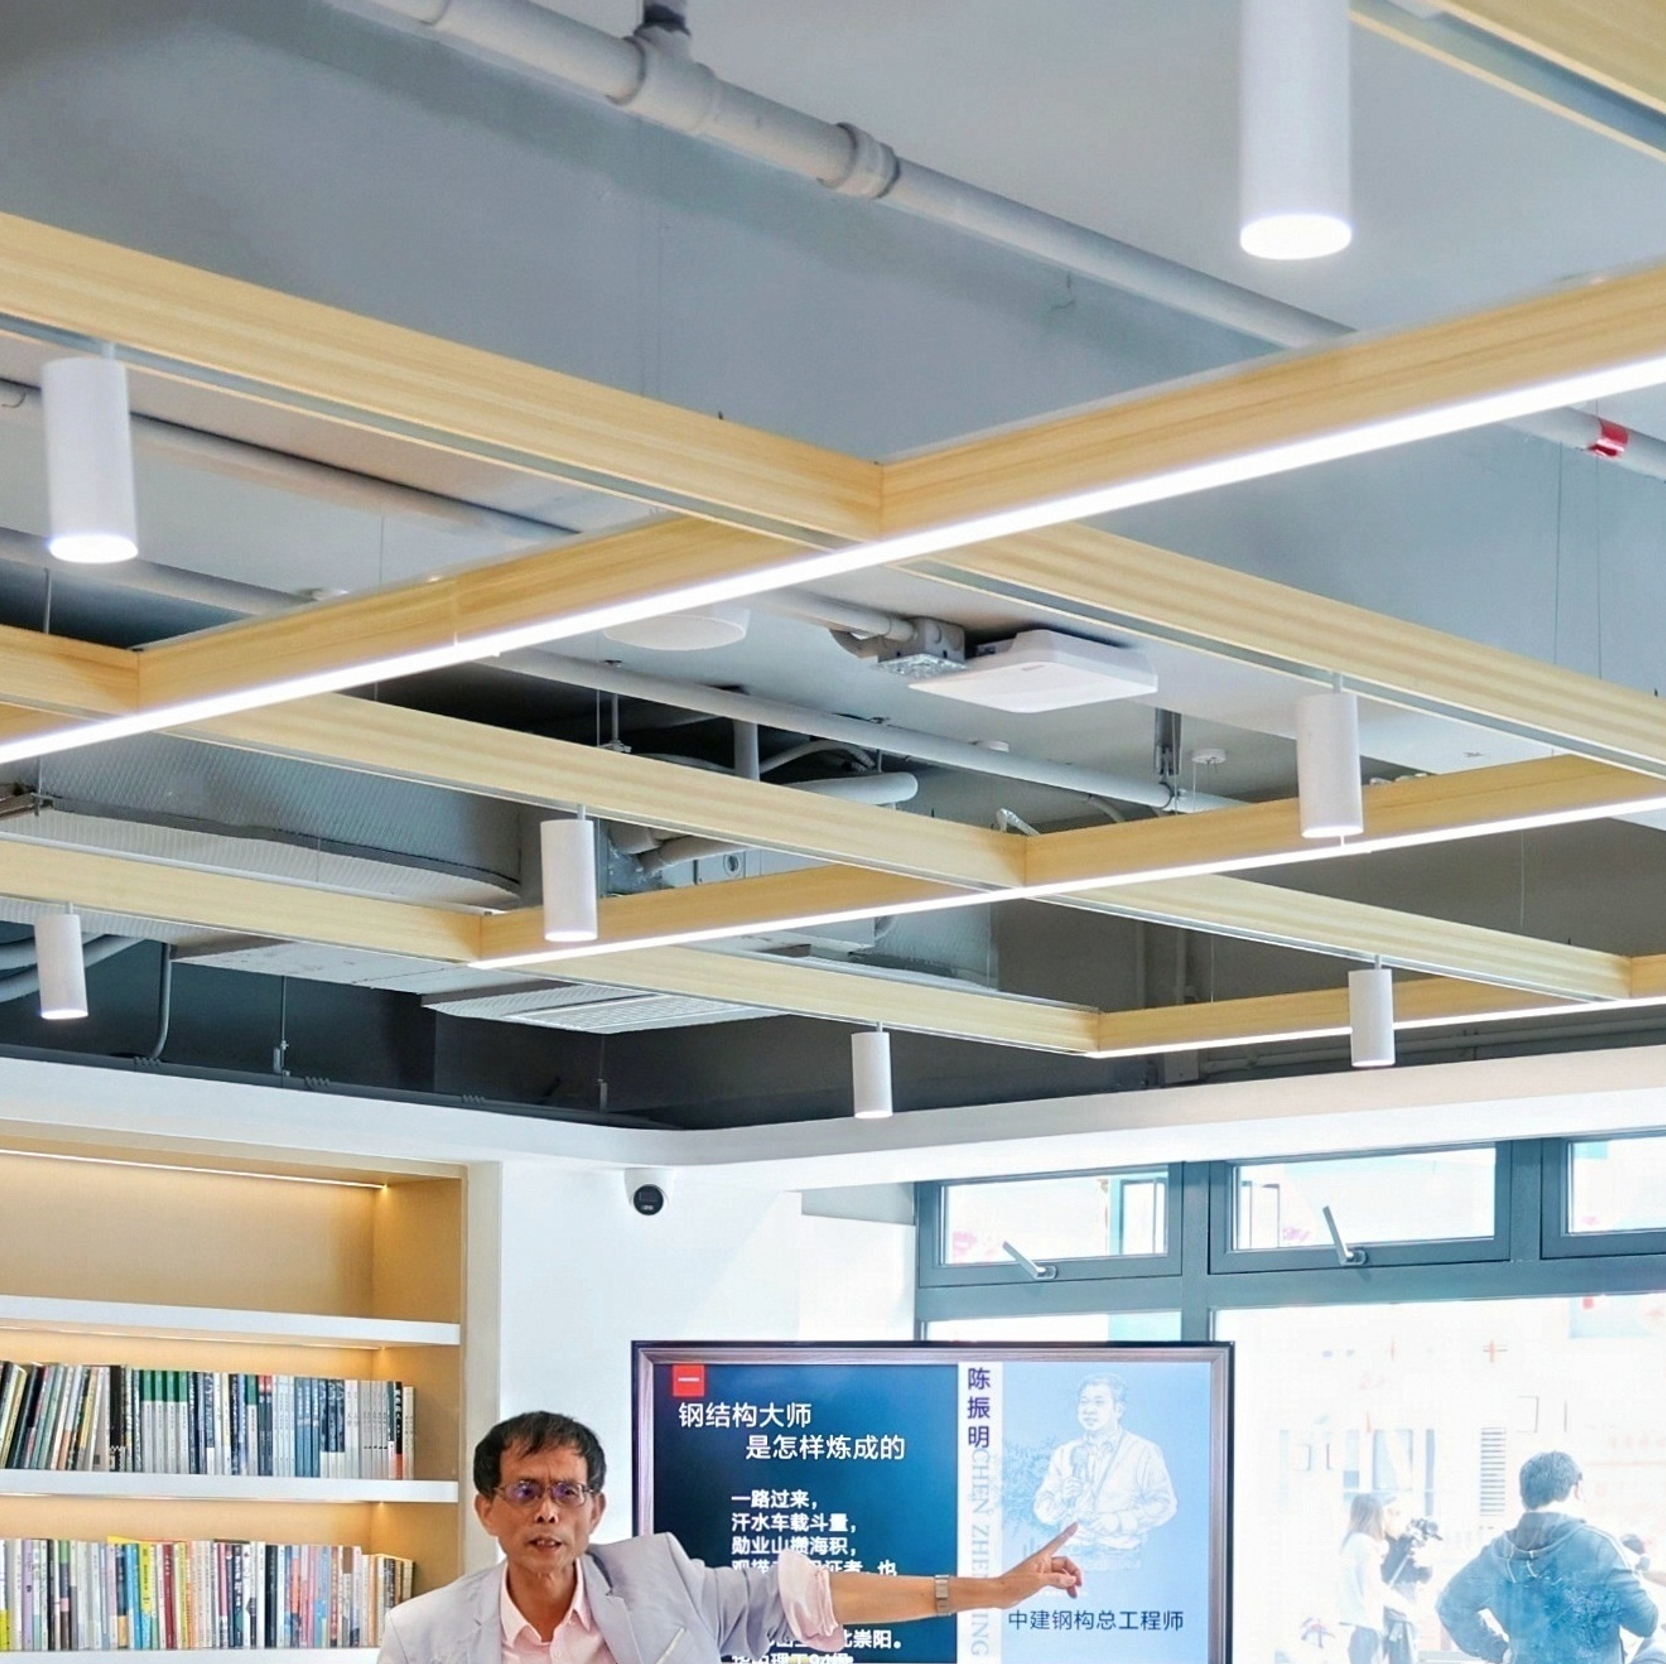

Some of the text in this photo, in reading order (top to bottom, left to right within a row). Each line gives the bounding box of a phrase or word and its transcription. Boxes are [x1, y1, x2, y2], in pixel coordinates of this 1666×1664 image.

[679, 1402, 812, 1428] 钢结构大师
[967, 1367, 991, 1449] 陈振明
[745, 1435, 905, 1460] 是怎样炼成的
[1008, 1610, 1184, 1631] 中建钢构总工程师
